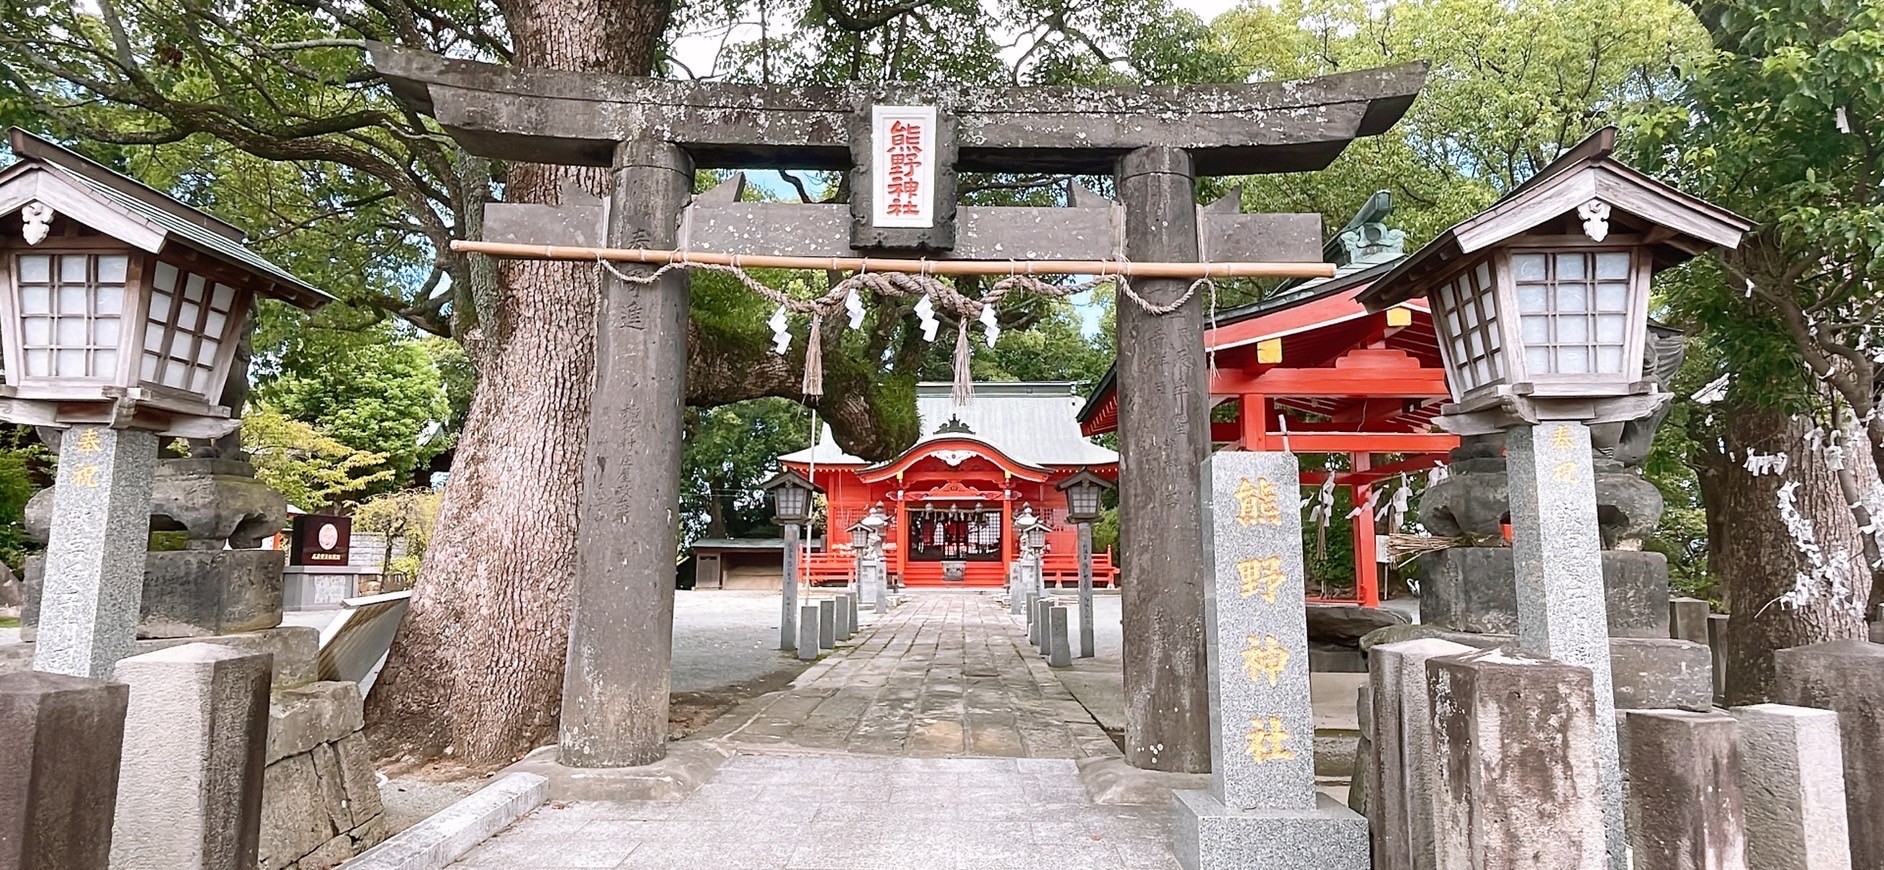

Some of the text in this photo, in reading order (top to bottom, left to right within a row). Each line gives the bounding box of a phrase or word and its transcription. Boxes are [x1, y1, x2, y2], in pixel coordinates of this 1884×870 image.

[886, 120, 923, 216] 熊野神社
[72, 427, 101, 488] 奉祝
[1550, 425, 1581, 485] 奉祝
[1234, 476, 1295, 765] 熊野神社
